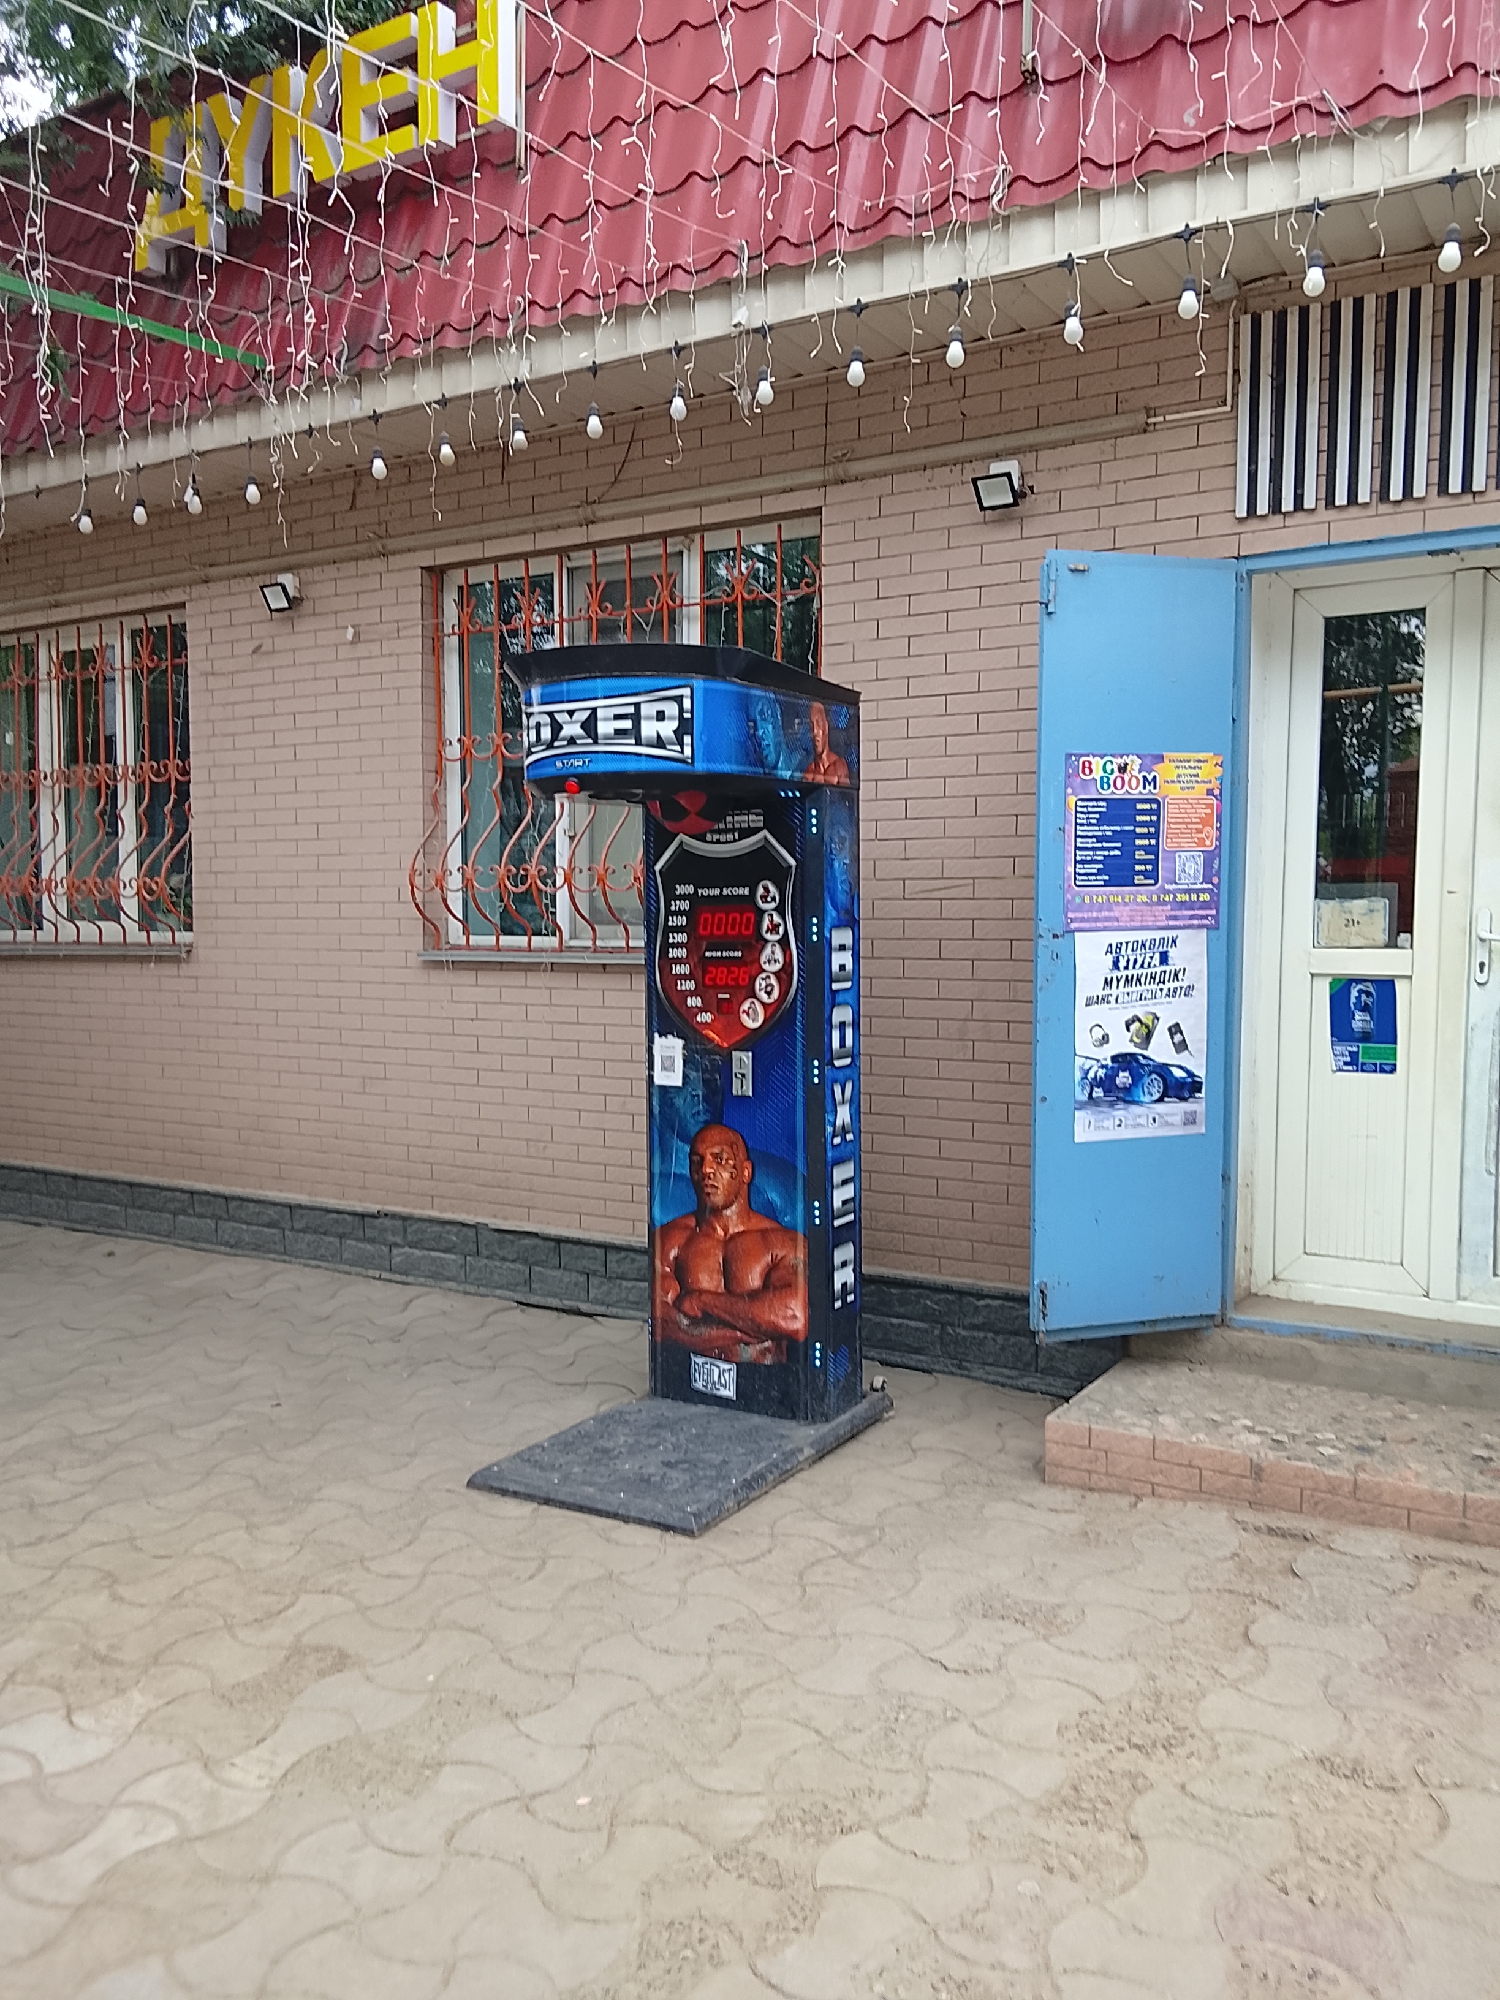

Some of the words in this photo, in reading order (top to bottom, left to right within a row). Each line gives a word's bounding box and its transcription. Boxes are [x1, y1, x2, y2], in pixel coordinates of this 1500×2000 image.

[523, 700, 682, 752] OXER
[556, 758, 590, 770] START
[1081, 759, 1115, 776] BIG
[1099, 774, 1157, 791] BOOM
[675, 884, 694, 895] 3000
[697, 887, 720, 897] YOUR
[722, 886, 750, 896] SCORE
[699, 912, 755, 936] 0000
[1344, 918, 1361, 928] 21+
[722, 950, 742, 958] SCORE
[1102, 967, 1187, 991] МҮМКІНДІК!
[687, 996, 702, 1007] 800
[1085, 993, 1113, 1007] ШАНС
[1164, 984, 1195, 999] АВТО!
[696, 1012, 712, 1023] 400
[831, 925, 856, 1311] BOXER
